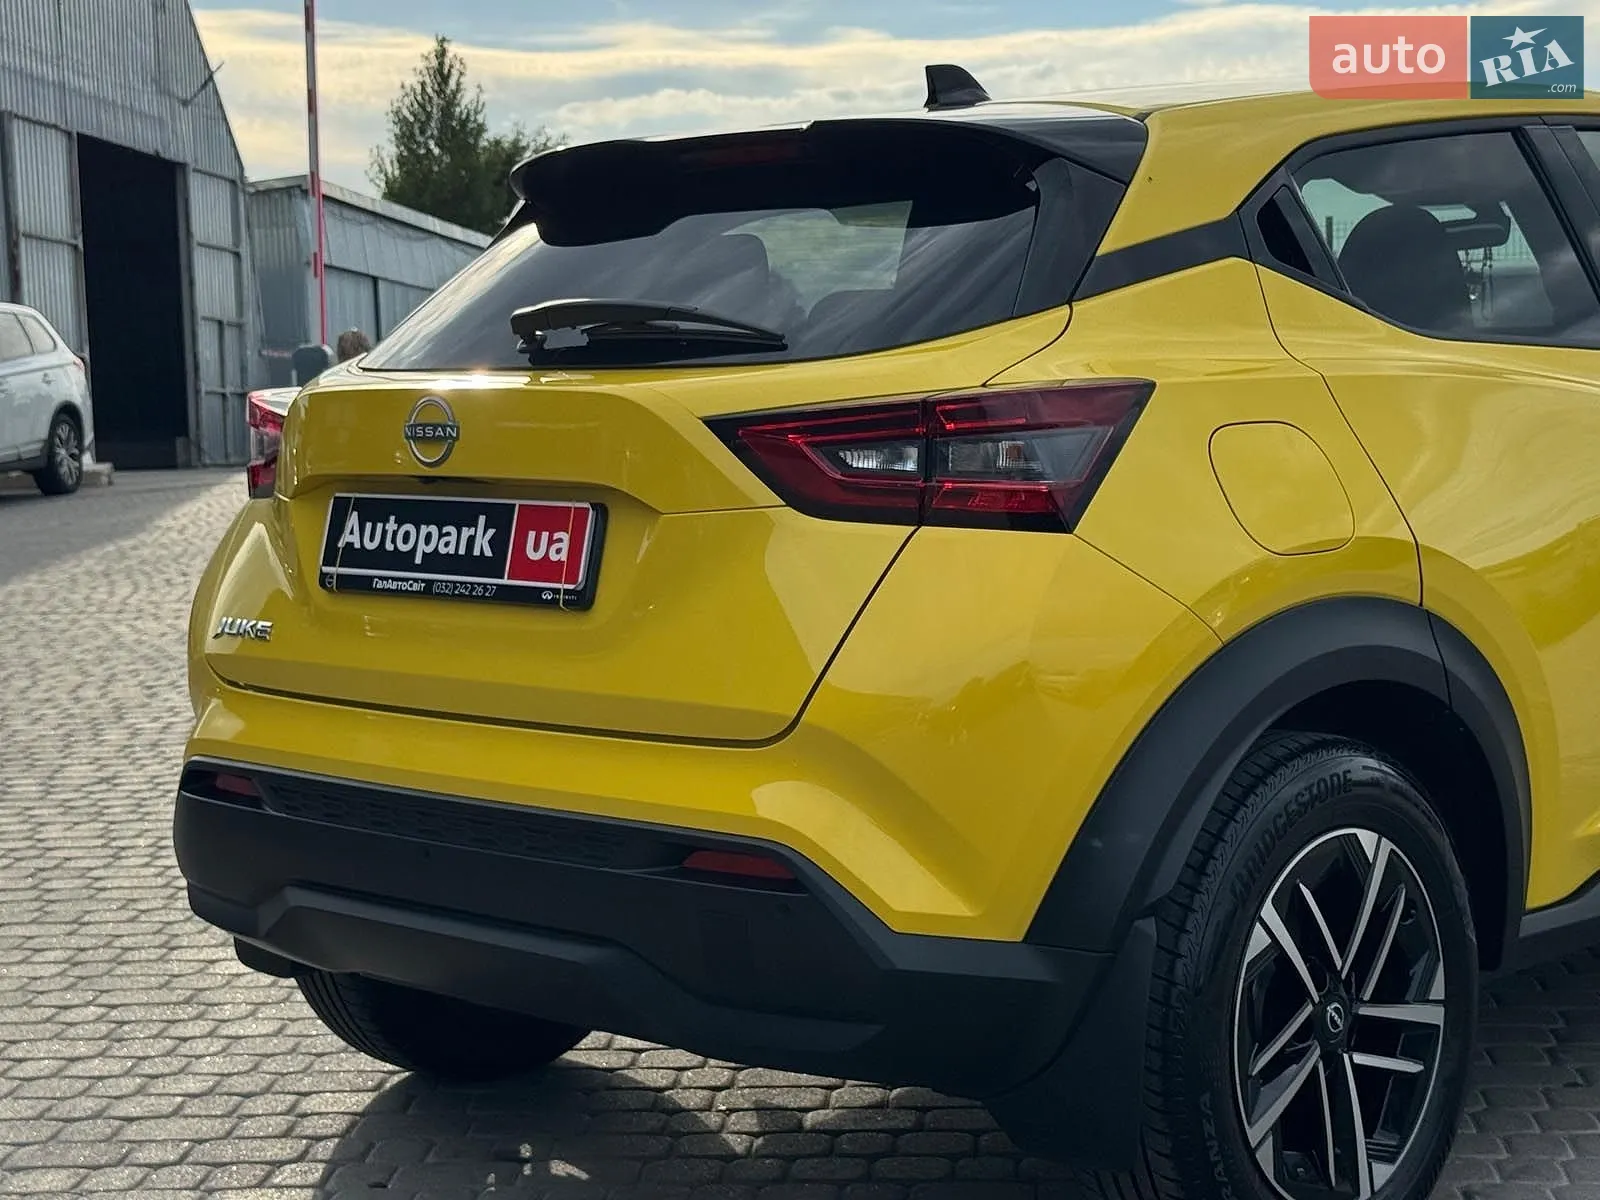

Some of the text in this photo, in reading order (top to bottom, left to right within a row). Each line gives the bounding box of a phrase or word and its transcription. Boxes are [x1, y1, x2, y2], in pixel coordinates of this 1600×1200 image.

[405, 426, 457, 438] NISSAN
[337, 509, 571, 565] Autopark ua
[432, 582, 453, 595] (032)
[454, 583, 471, 596] 242
[472, 585, 484, 597] 26
[485, 586, 497, 597] 27
[212, 616, 274, 641] JUKE
[1230, 768, 1354, 902] BRIDGESTONE
